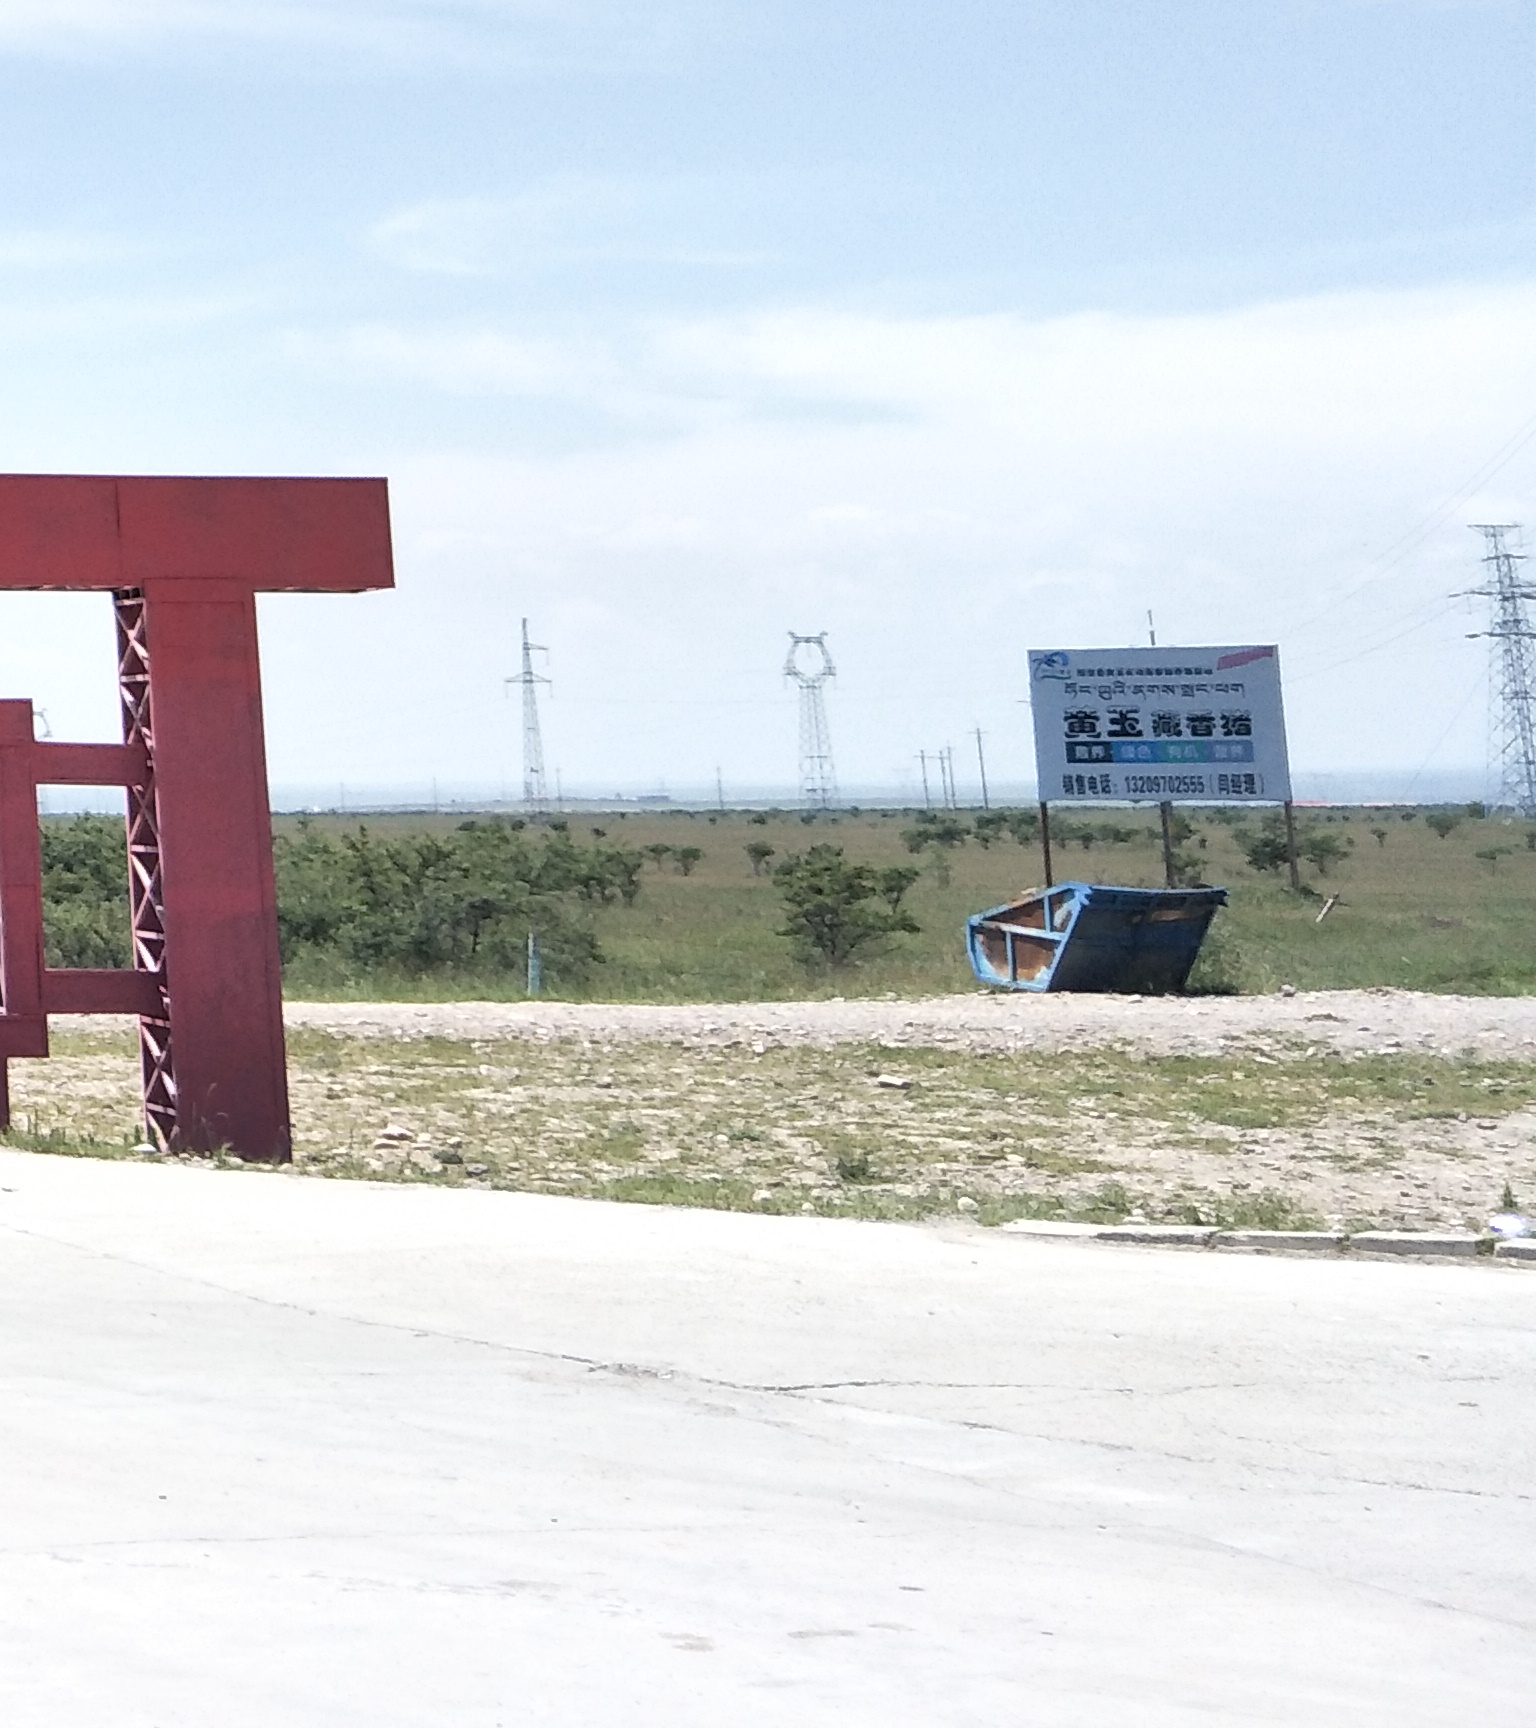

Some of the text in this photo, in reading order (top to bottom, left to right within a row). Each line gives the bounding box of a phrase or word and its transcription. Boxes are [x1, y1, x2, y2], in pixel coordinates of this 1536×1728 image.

[1063, 705, 1252, 738] 黄玉藏香猪
